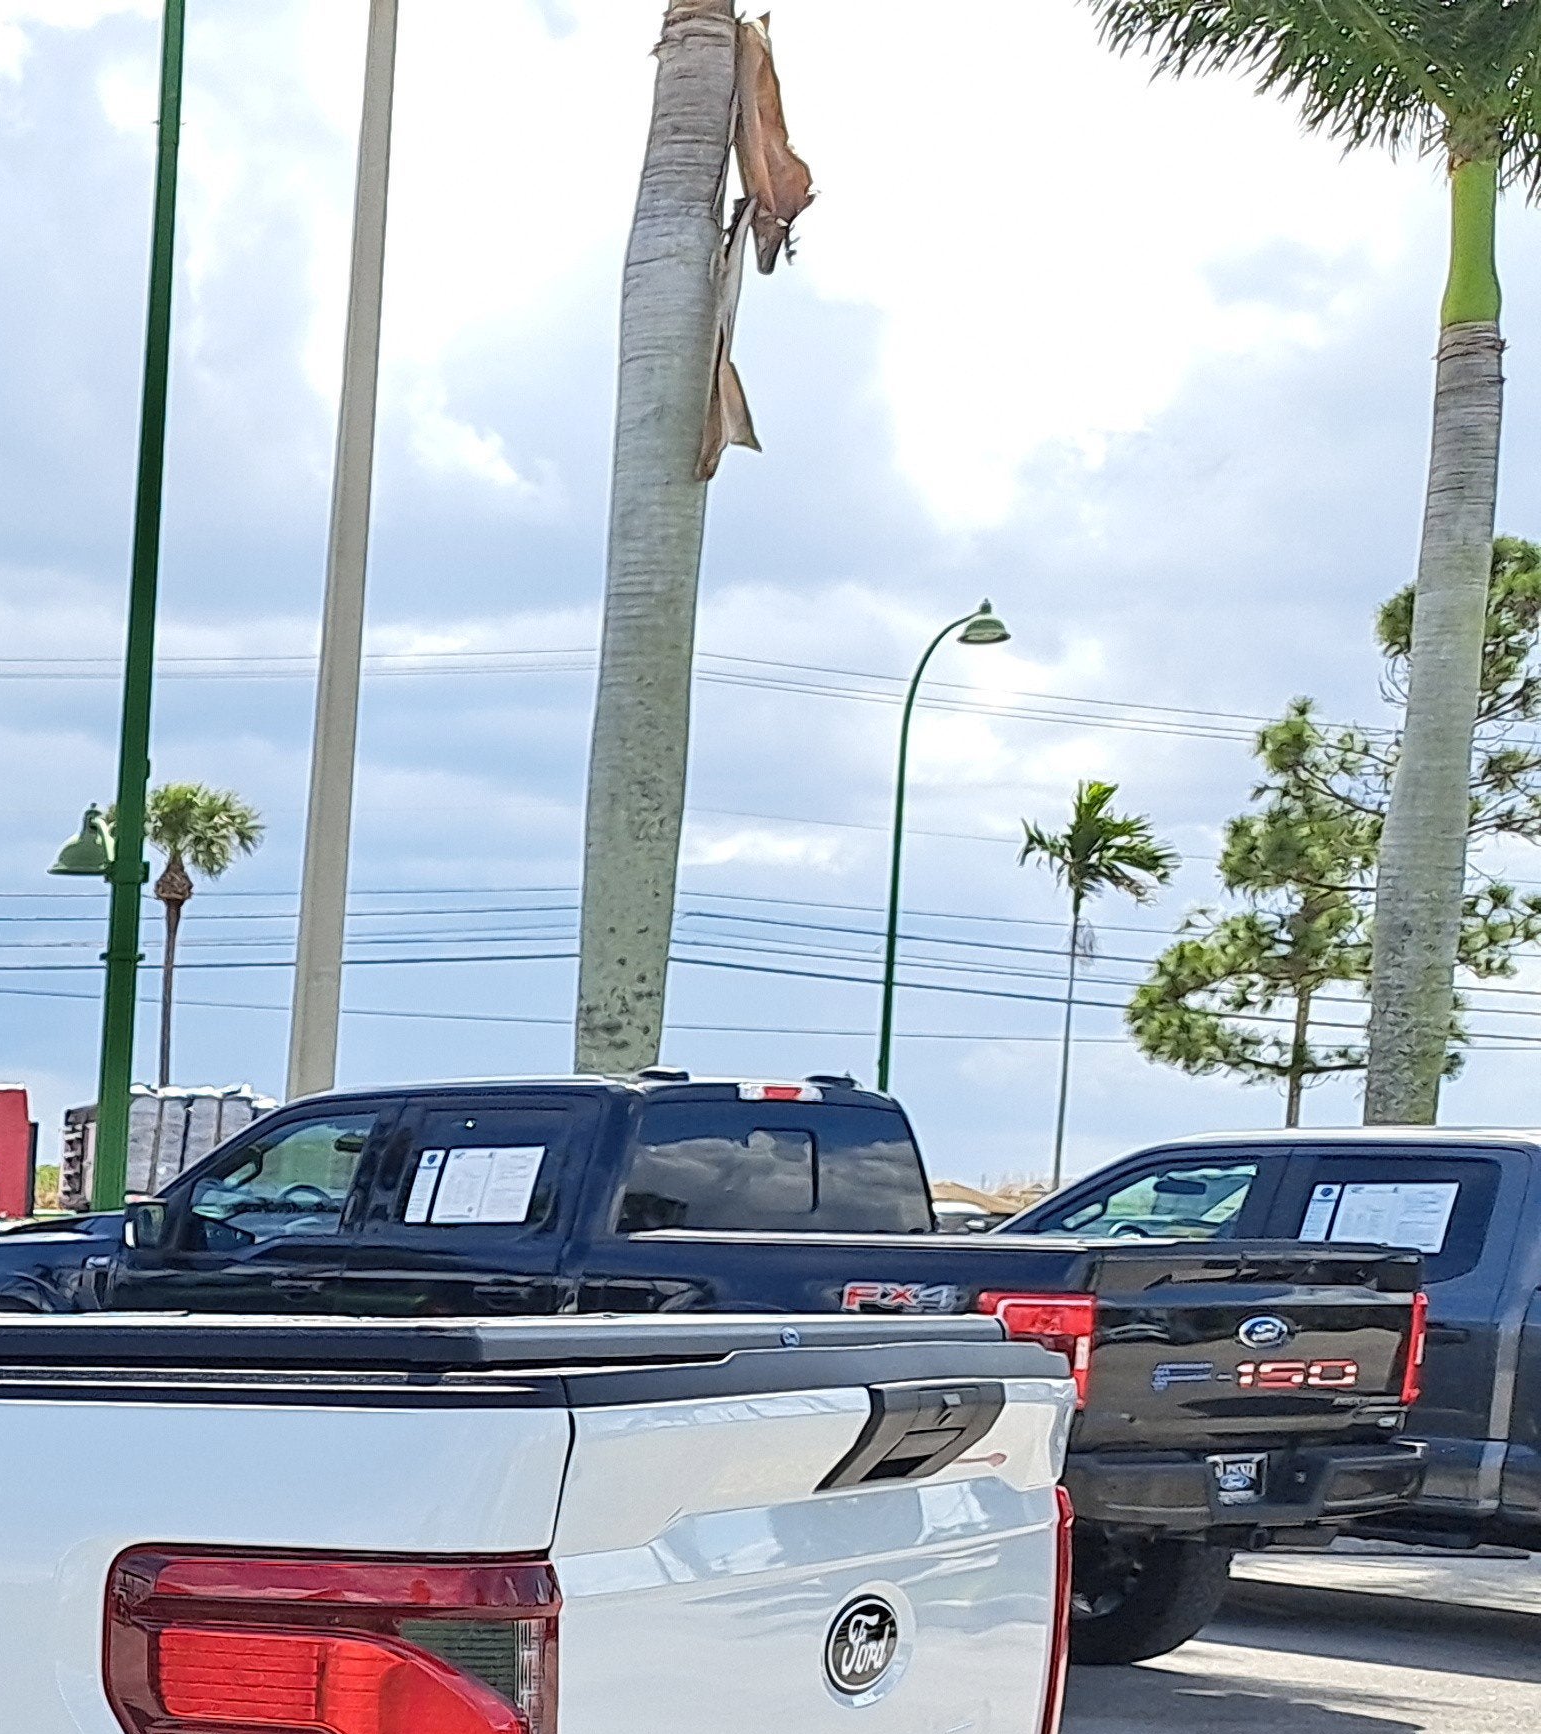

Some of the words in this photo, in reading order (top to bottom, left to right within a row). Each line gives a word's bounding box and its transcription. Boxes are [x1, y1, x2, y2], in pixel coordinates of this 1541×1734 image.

[841, 1281, 958, 1313] FX4
[1151, 1358, 1359, 1392] F-150
[839, 1612, 893, 1679] Ford
